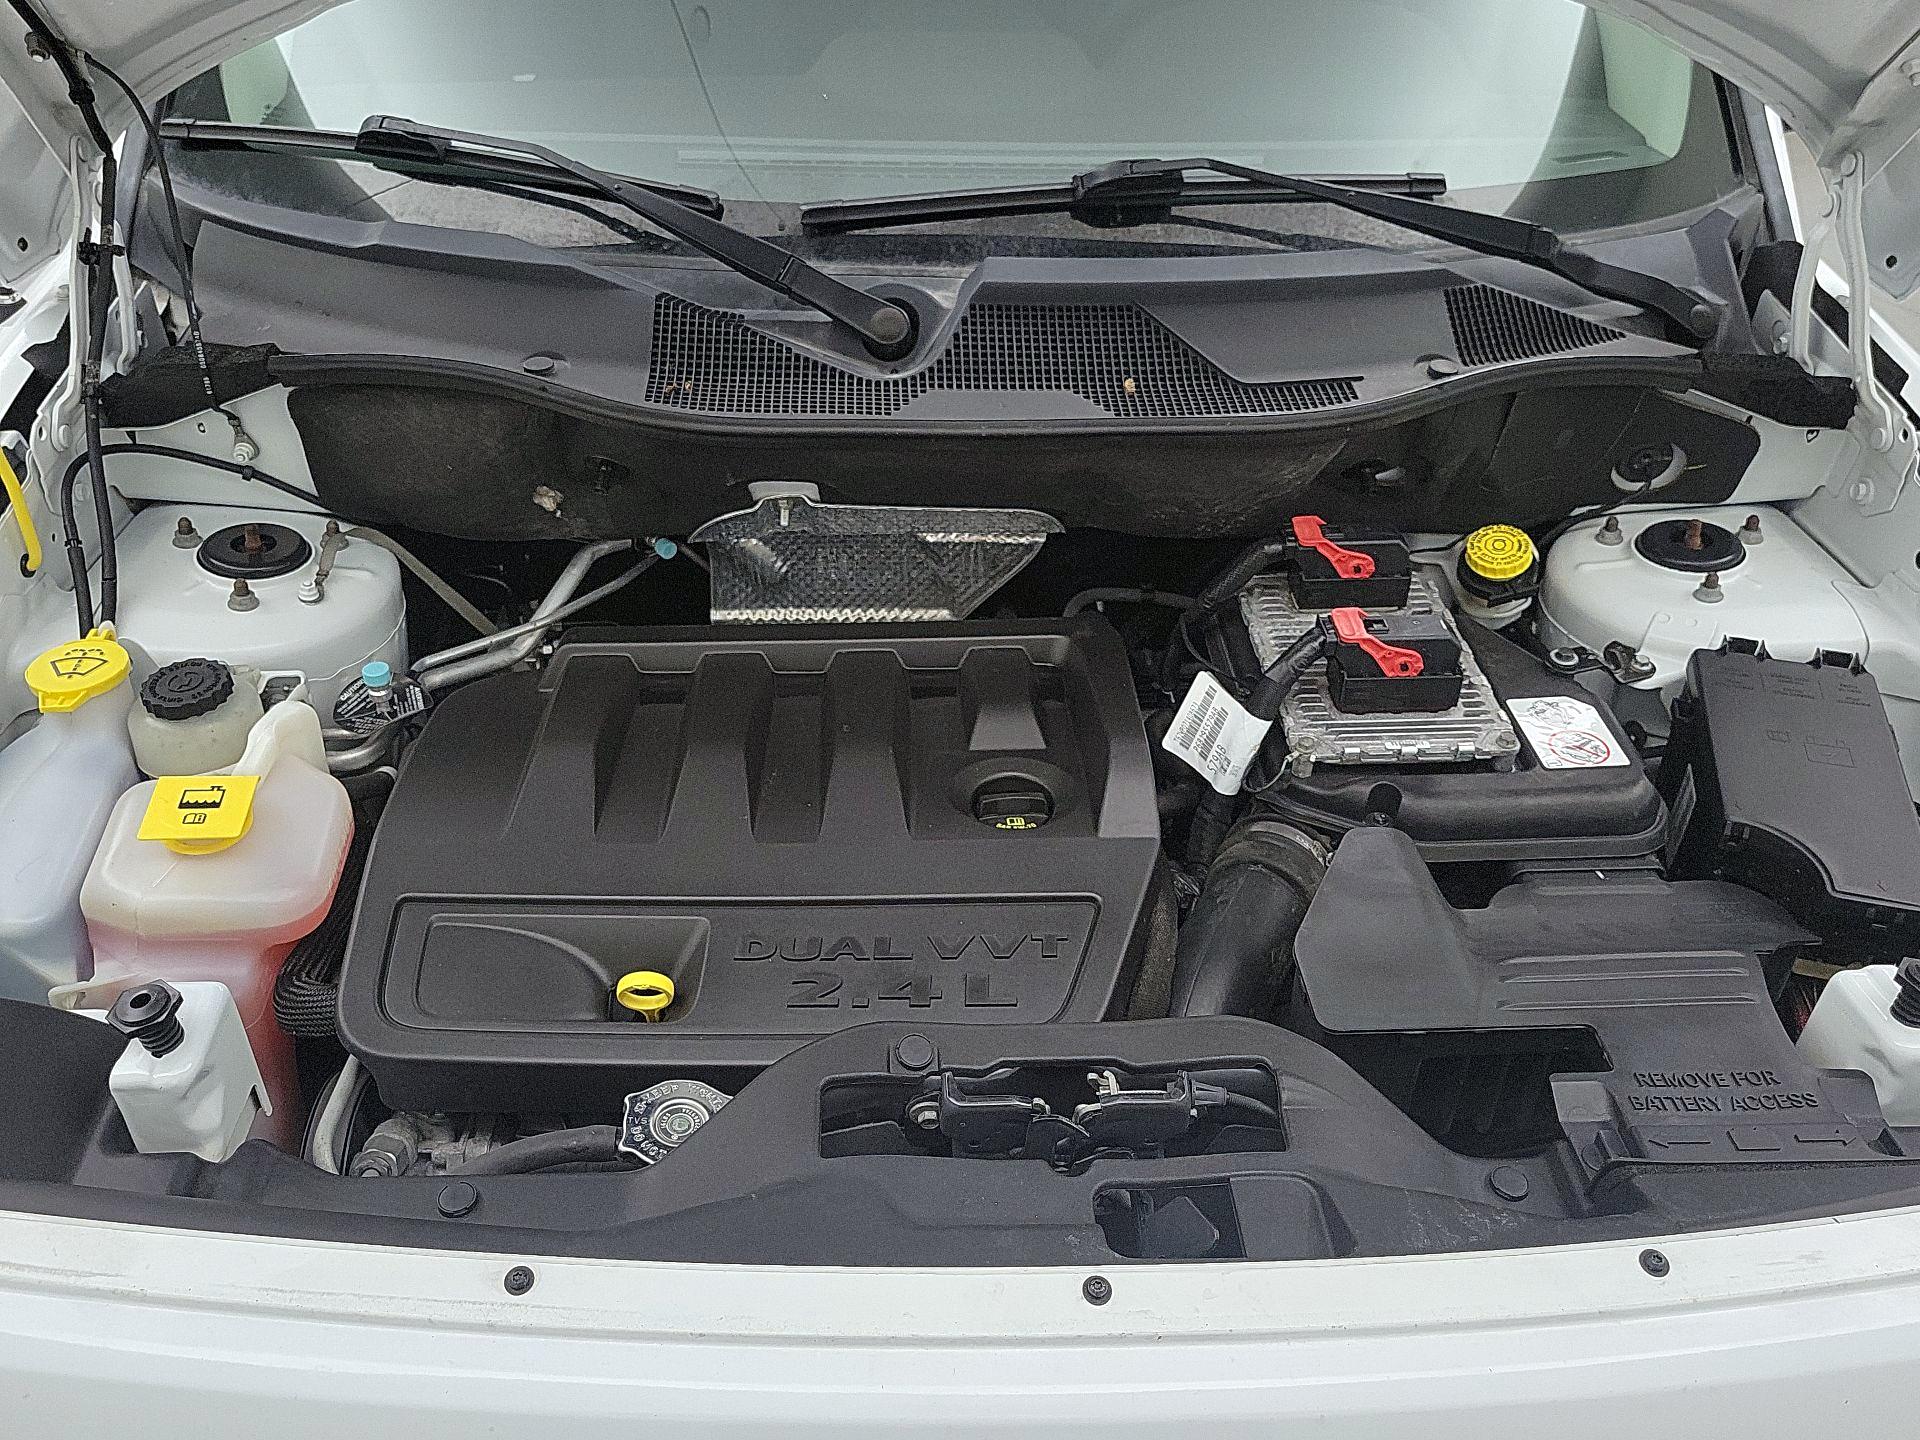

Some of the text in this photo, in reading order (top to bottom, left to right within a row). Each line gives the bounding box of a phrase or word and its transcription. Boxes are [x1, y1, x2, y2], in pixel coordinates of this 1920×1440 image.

[1206, 744, 1227, 775] 579AB
[733, 934, 1069, 962] DUAL VVT
[1633, 1070, 1782, 1089] REMOVE FOR
[1627, 1091, 1819, 1112] BATTERY ACCESS
[627, 1115, 649, 1125] TVS
